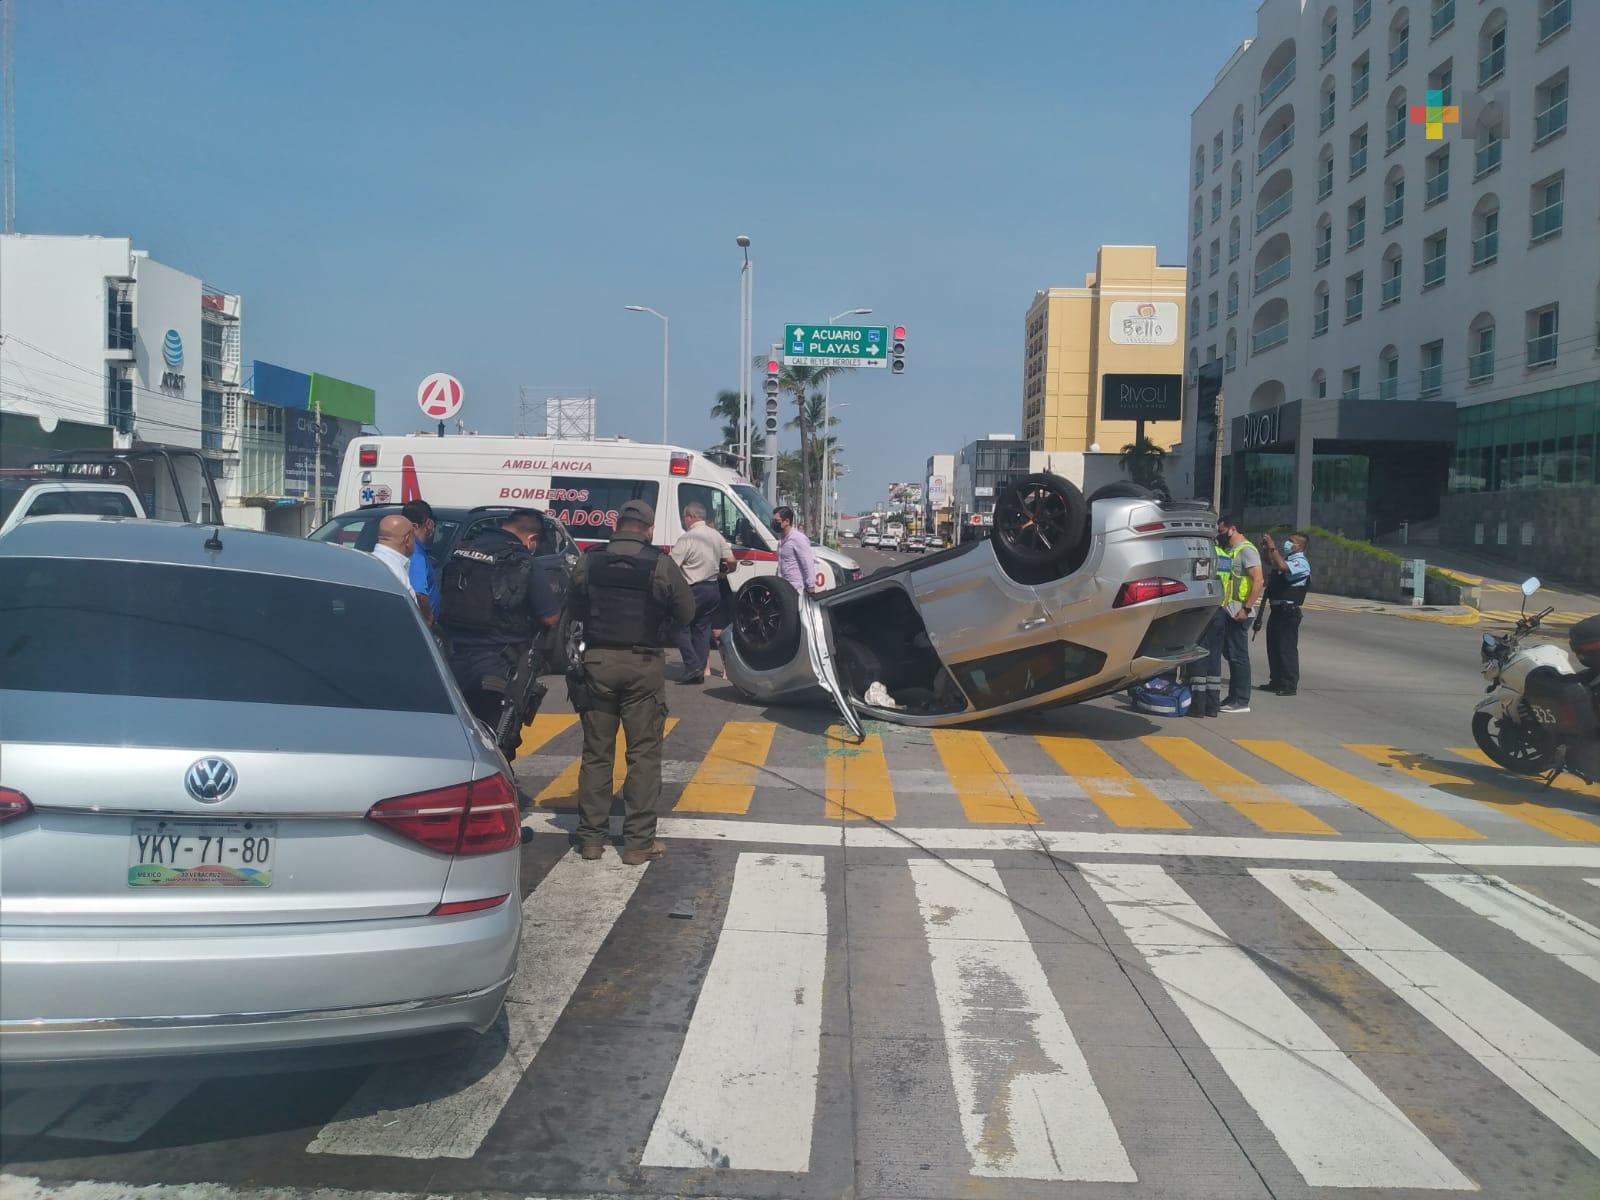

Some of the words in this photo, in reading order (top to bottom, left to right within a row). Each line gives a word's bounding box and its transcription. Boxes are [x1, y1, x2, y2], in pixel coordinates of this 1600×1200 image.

[1122, 318, 1163, 336] Bello
[811, 329, 862, 341] ACUARIO
[809, 343, 860, 354] PLAYAS
[810, 358, 831, 366] REYES
[160, 371, 186, 391] AT&T
[1119, 383, 1167, 403] RIVOLI
[1243, 403, 1280, 448] RIVOLI
[502, 459, 592, 472] AMBULANCIA
[499, 488, 590, 501] BOMBEROS
[453, 549, 495, 563] POLICIA
[137, 834, 270, 864] YKY-71-80
